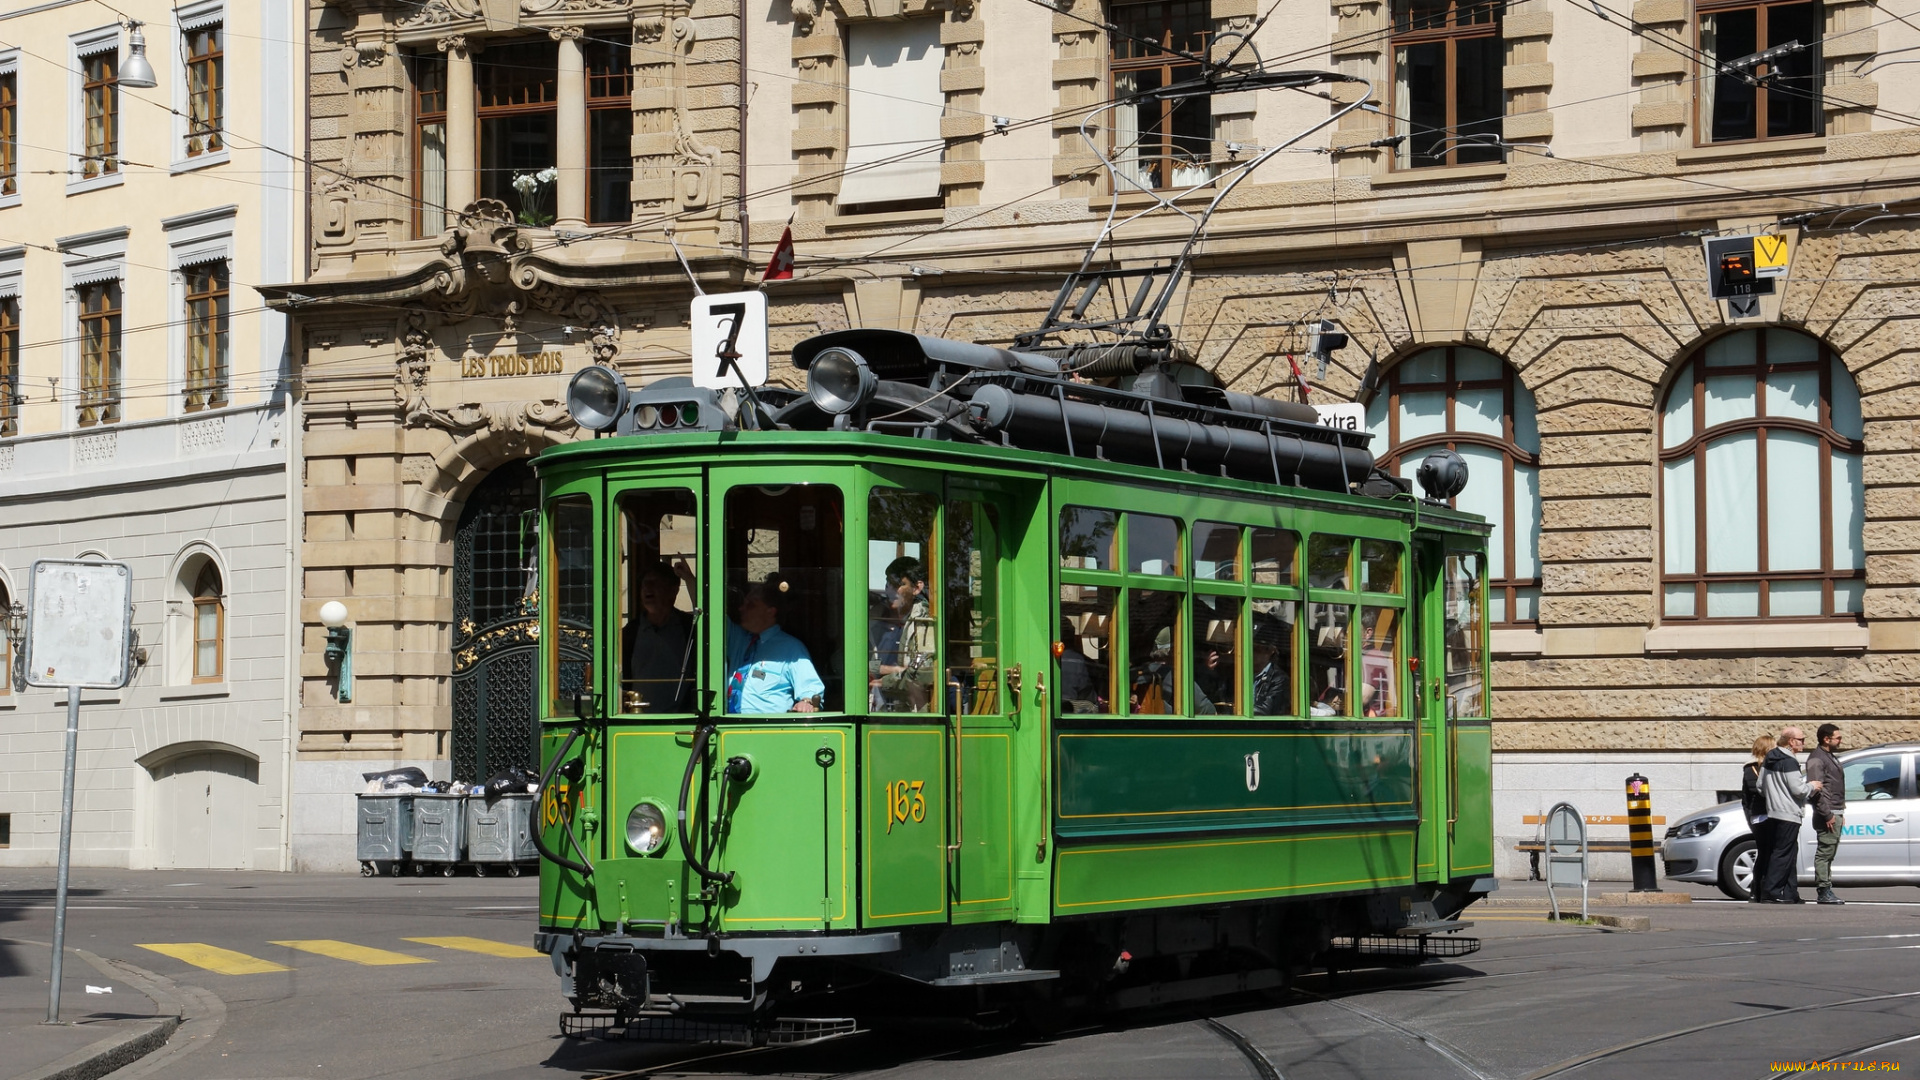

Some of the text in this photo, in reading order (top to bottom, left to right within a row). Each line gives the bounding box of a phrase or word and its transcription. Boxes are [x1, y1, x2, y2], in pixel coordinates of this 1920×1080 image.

[1734, 284, 1751, 295] 118
[709, 302, 746, 378] 7
[461, 351, 564, 377] LES TROIS ROIS
[1317, 411, 1357, 430] xtra
[886, 780, 926, 835] 163
[1841, 824, 1886, 836] MENS
